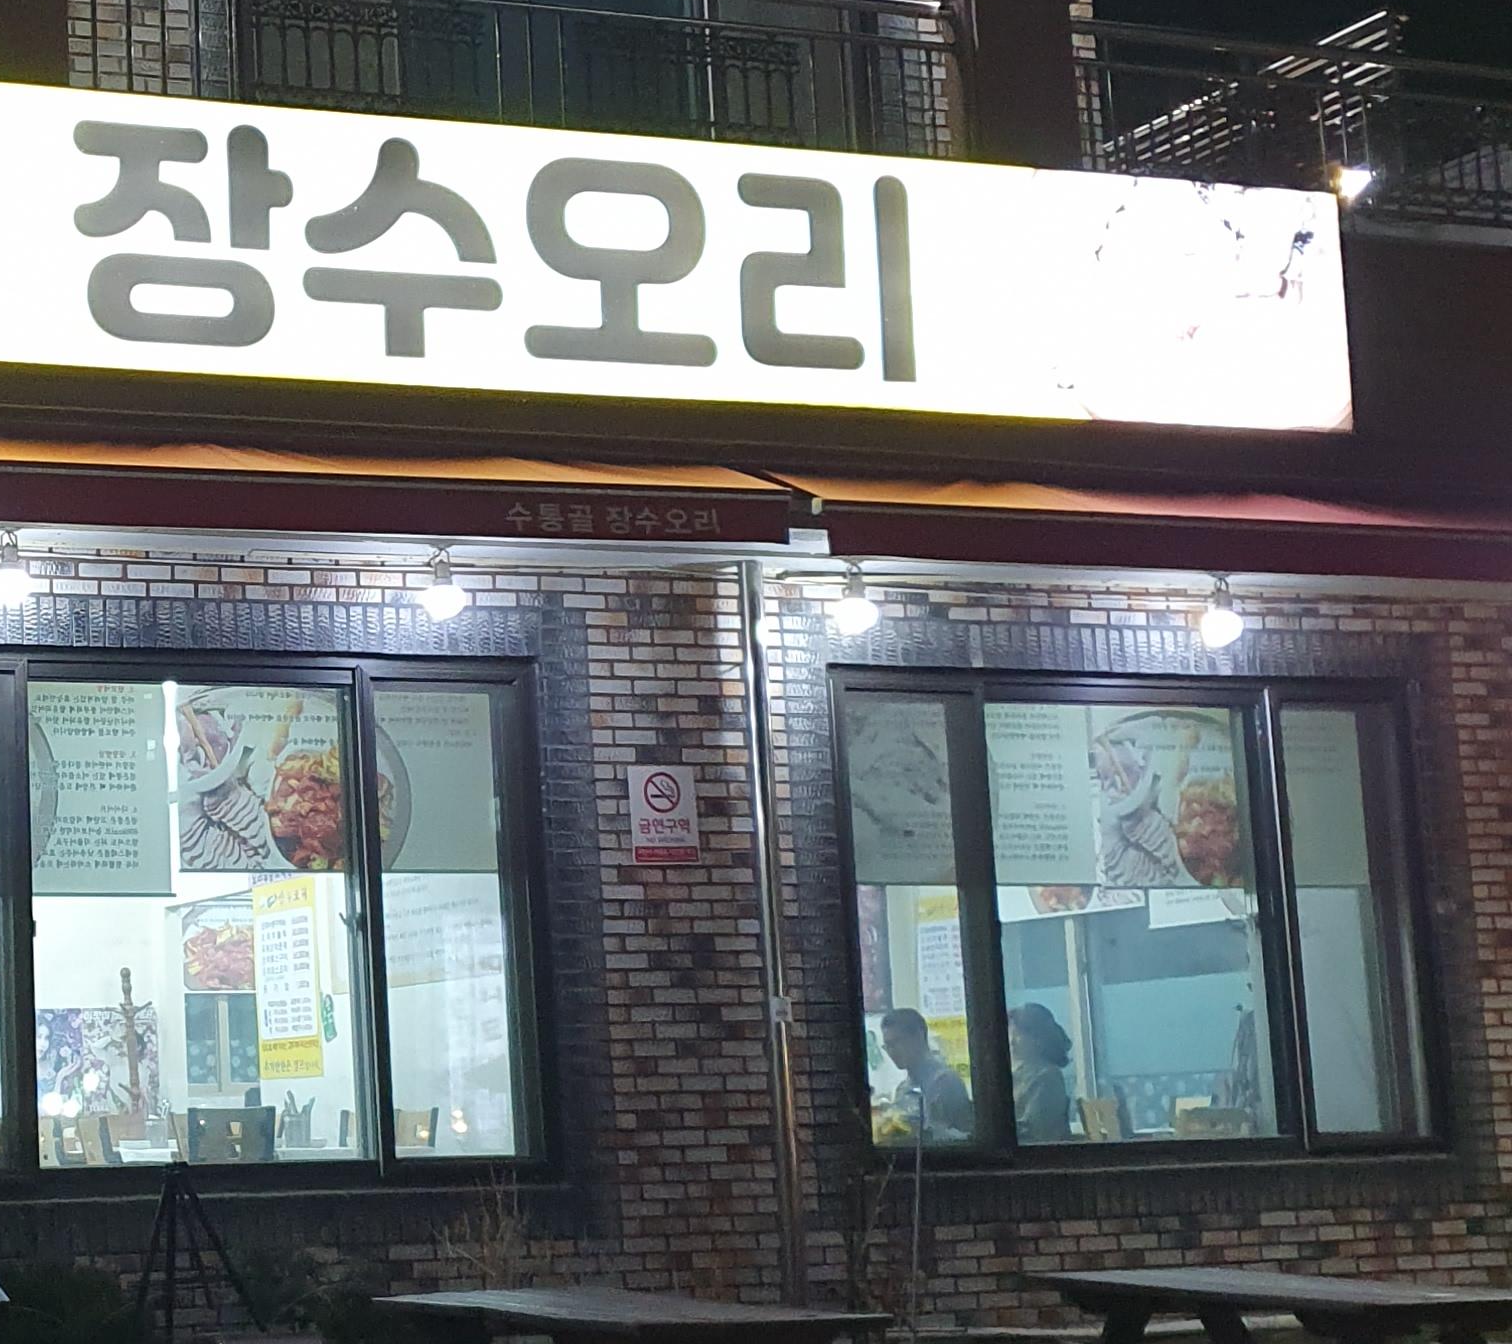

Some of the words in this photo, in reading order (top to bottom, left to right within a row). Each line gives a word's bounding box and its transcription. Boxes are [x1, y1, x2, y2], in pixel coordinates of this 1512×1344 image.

[72, 120, 917, 382] 장수오리
[505, 501, 593, 534] 수통골
[605, 505, 721, 535] 장수오리
[639, 818, 691, 834] 금연구역
